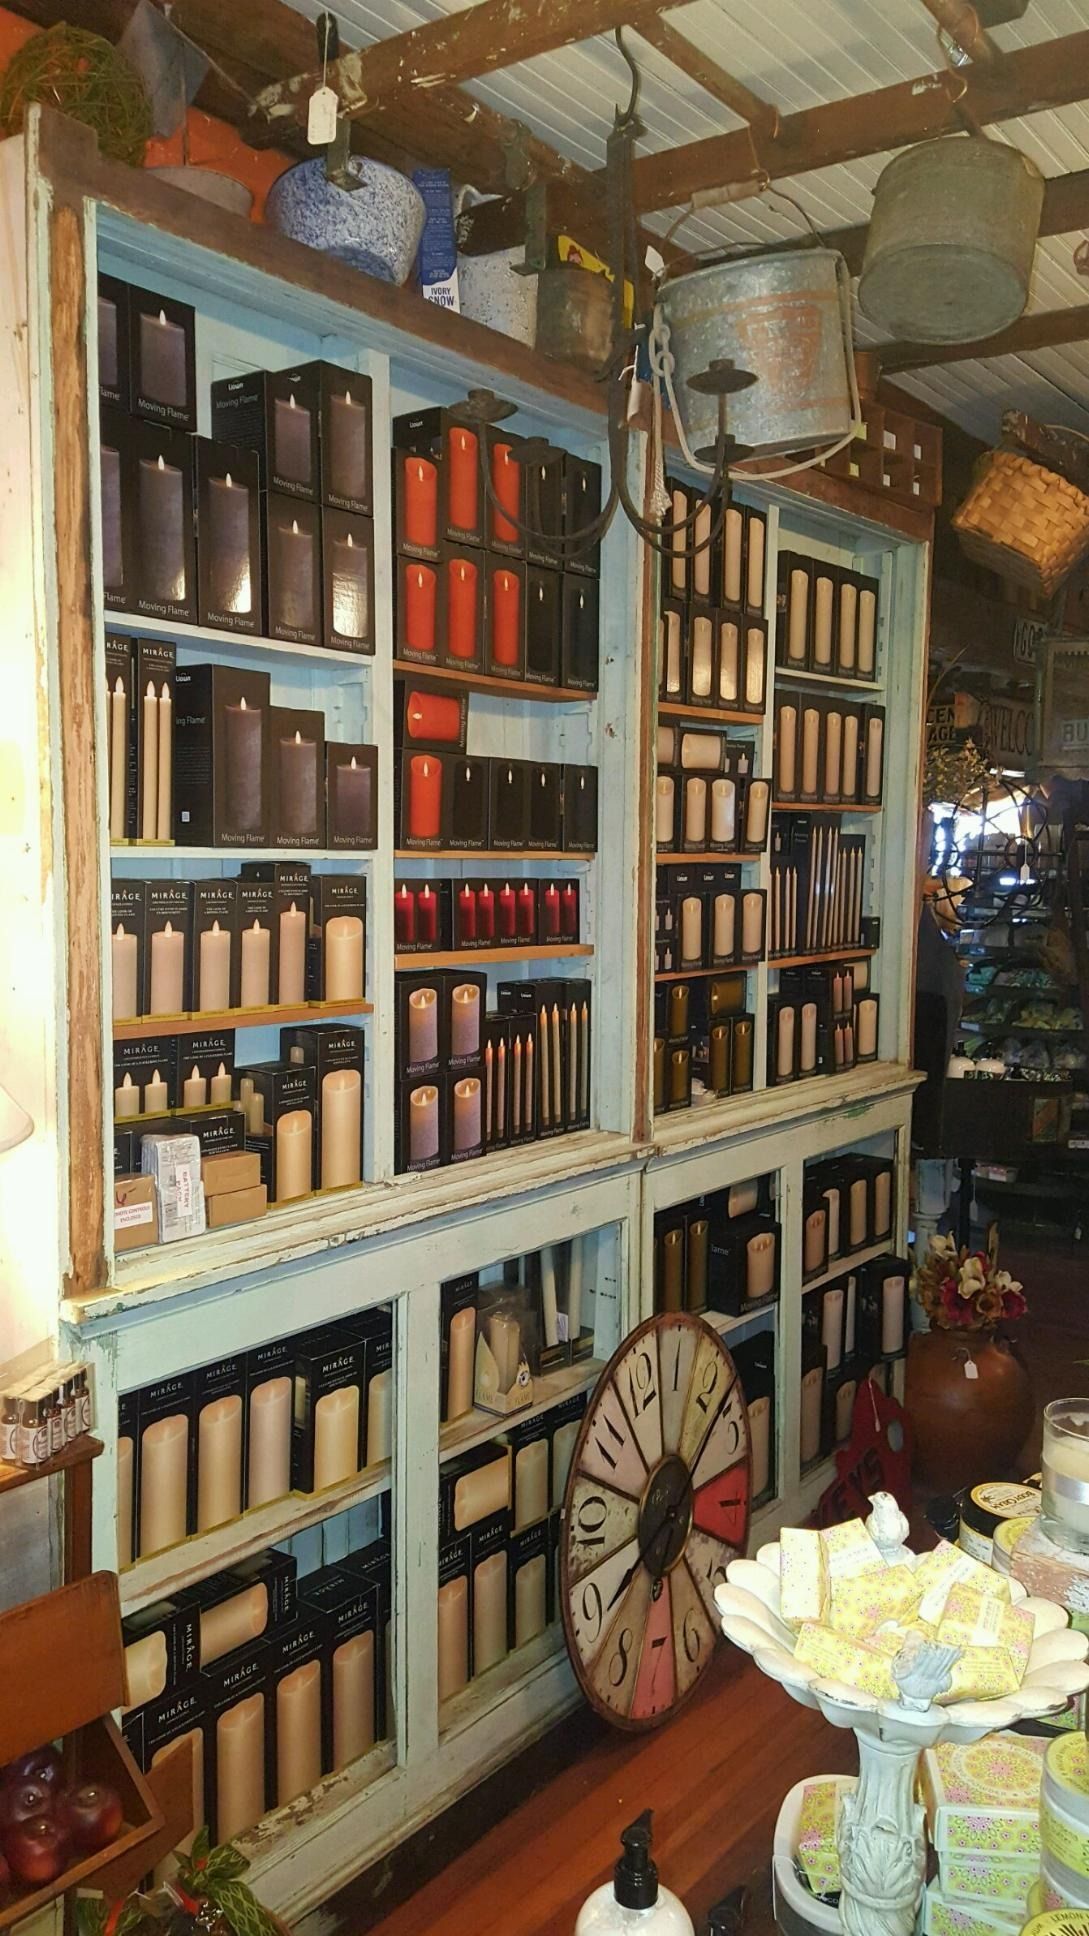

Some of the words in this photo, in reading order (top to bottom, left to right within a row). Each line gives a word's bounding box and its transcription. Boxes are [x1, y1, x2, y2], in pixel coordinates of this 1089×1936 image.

[431, 287, 451, 296] IVORY
[99, 387, 121, 400] lame
[216, 396, 238, 409] Moving
[239, 394, 258, 405] Flame
[138, 398, 166, 417] Moving
[167, 408, 190, 421] Flame
[273, 476, 296, 491] Moving
[296, 483, 313, 495] Flame
[328, 494, 350, 509] Moving
[350, 500, 368, 512] Flame
[103, 592, 126, 604] Flame
[138, 600, 165, 616] Moving
[166, 603, 190, 617] Flame
[207, 612, 233, 627] Moving
[234, 617, 255, 628] Flame
[275, 626, 297, 640] Moving
[298, 629, 316, 641] Flame
[107, 638, 129, 652] RÂGE
[331, 636, 352, 650] Moving
[353, 638, 370, 650] Flame
[187, 715, 206, 725] Flame
[221, 833, 245, 844] Moving
[246, 833, 264, 843] Flame
[277, 836, 297, 846] Moving
[298, 837, 319, 846] Flame
[333, 835, 353, 845] Moving
[354, 836, 373, 844] Flame
[406, 838, 425, 847] Moving
[426, 839, 441, 847] Flame
[450, 839, 467, 848] Moving
[111, 889, 142, 901] IRÂGE
[397, 943, 416, 951] Moving
[448, 1057, 464, 1065] Moving
[465, 1055, 480, 1064] Flame
[406, 1064, 424, 1074] Moving
[425, 1062, 439, 1071] Flame
[407, 1161, 424, 1172] Moving
[425, 1158, 440, 1167] Flame
[376, 1342, 391, 1353] MIR
[672, 1338, 681, 1391] 1
[628, 1352, 657, 1420] 12
[696, 1361, 718, 1414] 2
[721, 1402, 739, 1455] 3
[595, 1414, 625, 1471] 11
[719, 1490, 741, 1526] 4
[575, 1496, 607, 1546] 10
[582, 1582, 602, 1643] 9
[683, 1608, 700, 1663] 6
[609, 1628, 633, 1687] 8
[651, 1636, 667, 1694] 7
[1050, 1912, 1084, 1922] LEMON
